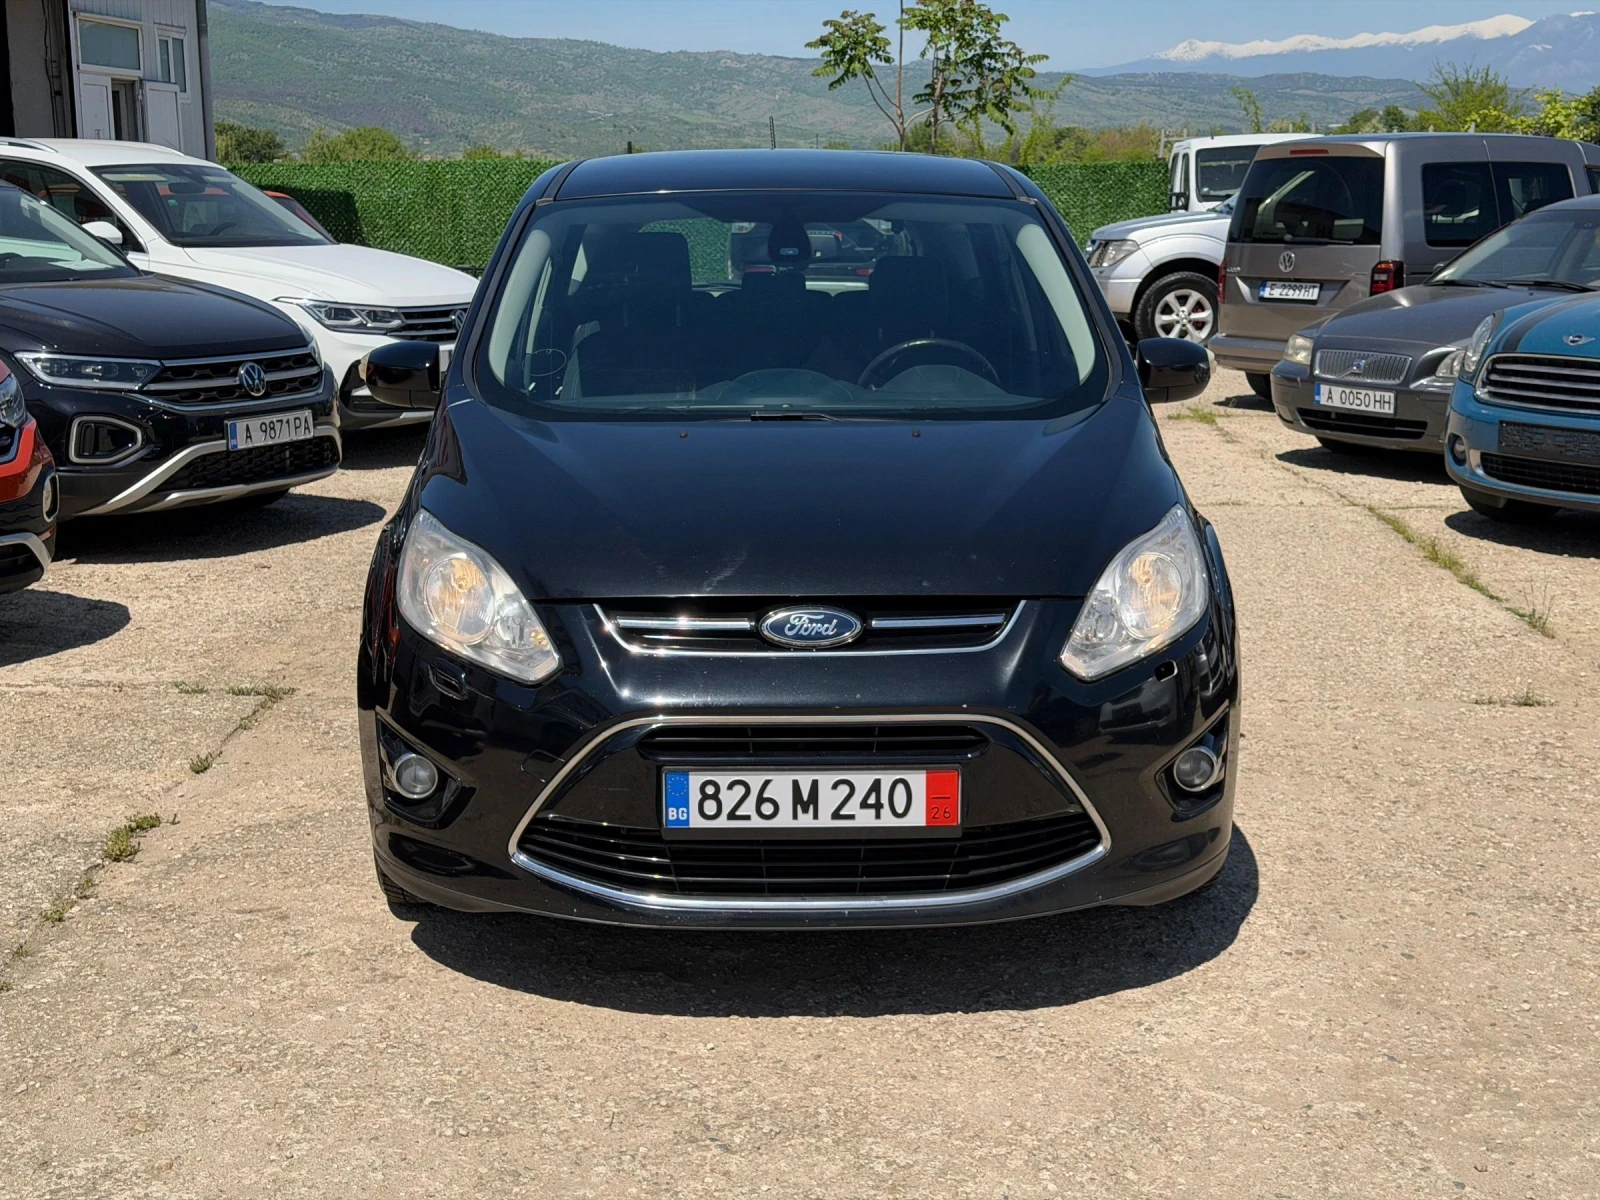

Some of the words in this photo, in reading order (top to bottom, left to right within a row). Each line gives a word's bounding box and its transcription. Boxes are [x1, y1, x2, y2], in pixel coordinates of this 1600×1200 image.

[1269, 283, 1277, 296] E
[1326, 387, 1334, 404] A
[245, 423, 253, 444] A
[784, 613, 838, 636] Ford
[697, 778, 780, 821] 826
[791, 778, 819, 821] M
[830, 777, 913, 821] 240
[668, 807, 688, 821] BG
[931, 806, 952, 820] 26
